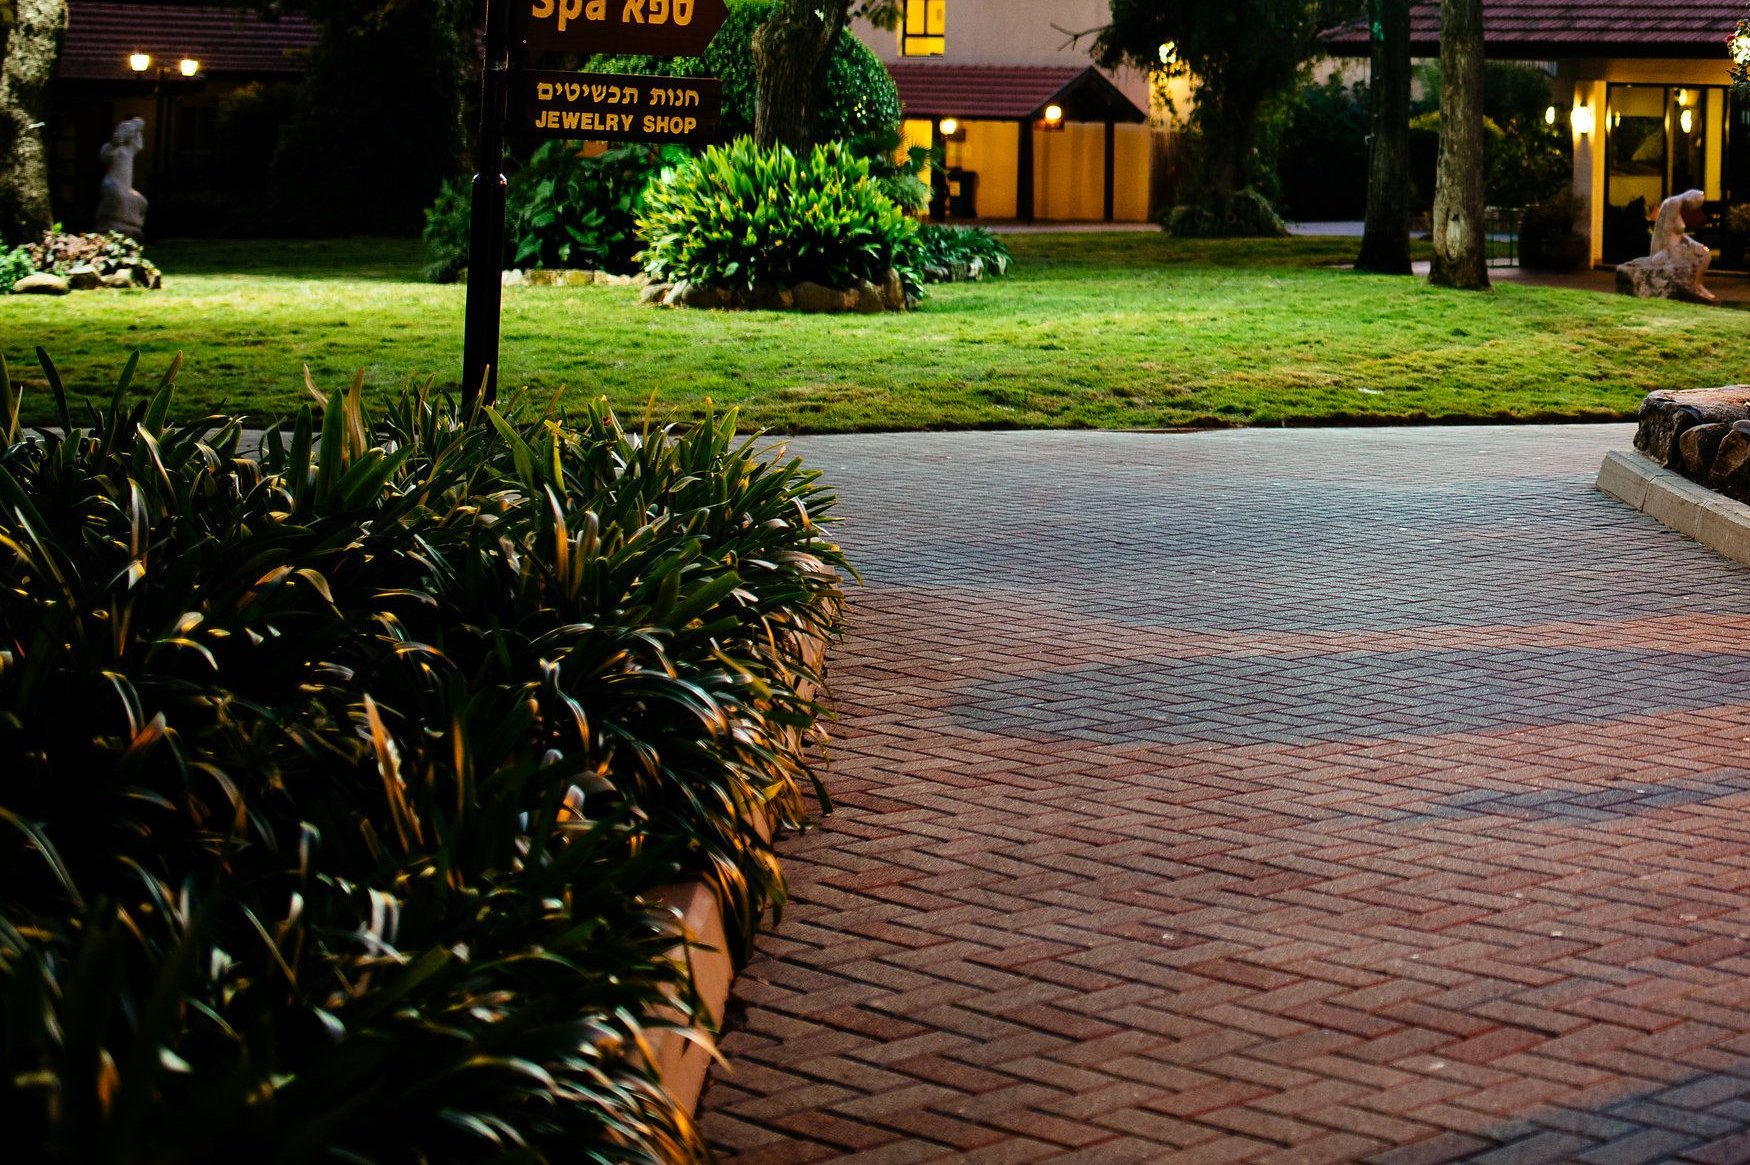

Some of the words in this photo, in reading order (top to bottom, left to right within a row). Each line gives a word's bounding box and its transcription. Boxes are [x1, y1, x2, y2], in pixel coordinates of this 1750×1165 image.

[536, 81, 639, 106] תכשיטים
[649, 87, 700, 108] חנות
[535, 110, 634, 132] JEWELRY
[643, 114, 698, 135] SHOP
